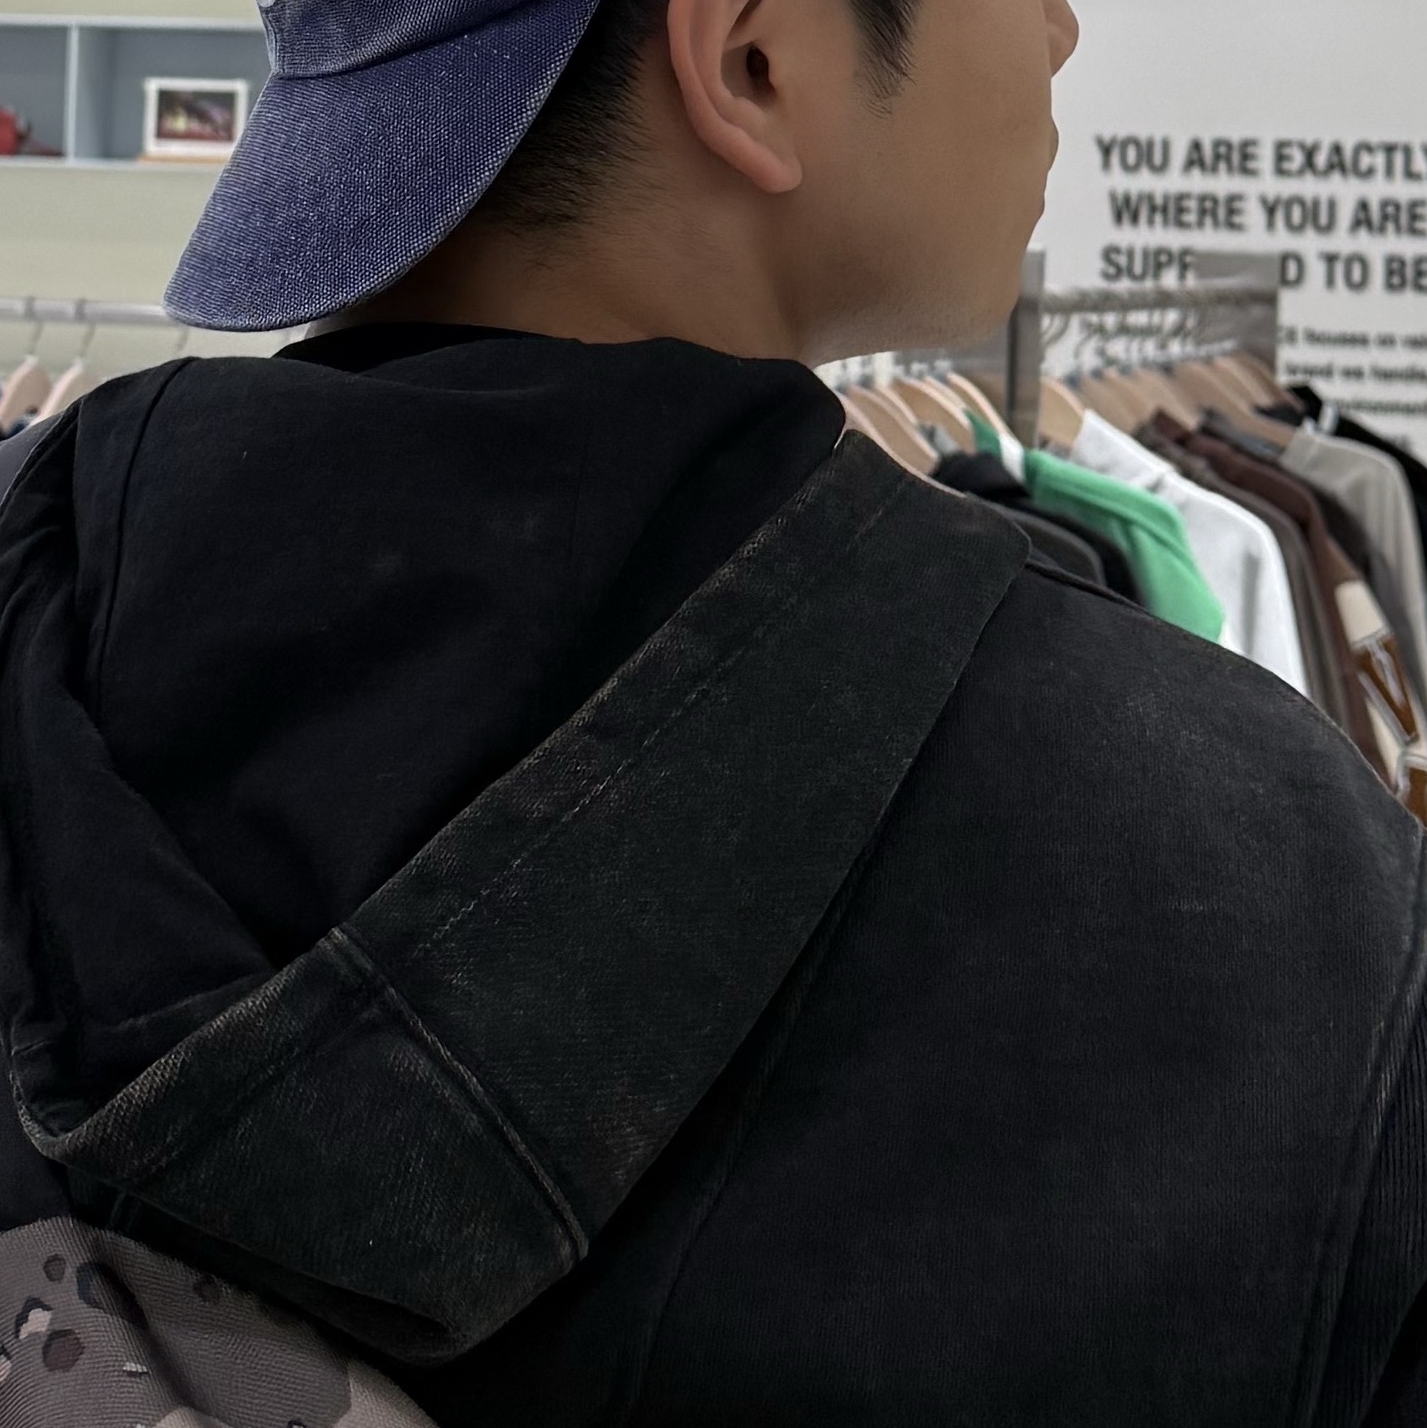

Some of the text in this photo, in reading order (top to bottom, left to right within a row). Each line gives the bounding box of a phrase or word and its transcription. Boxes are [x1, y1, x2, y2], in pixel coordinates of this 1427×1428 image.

[1094, 134, 1172, 176] YOU
[1181, 136, 1260, 179] ARE
[1108, 190, 1246, 234] WHERE
[1258, 193, 1339, 237] YOU
[1318, 250, 1372, 295] TO
